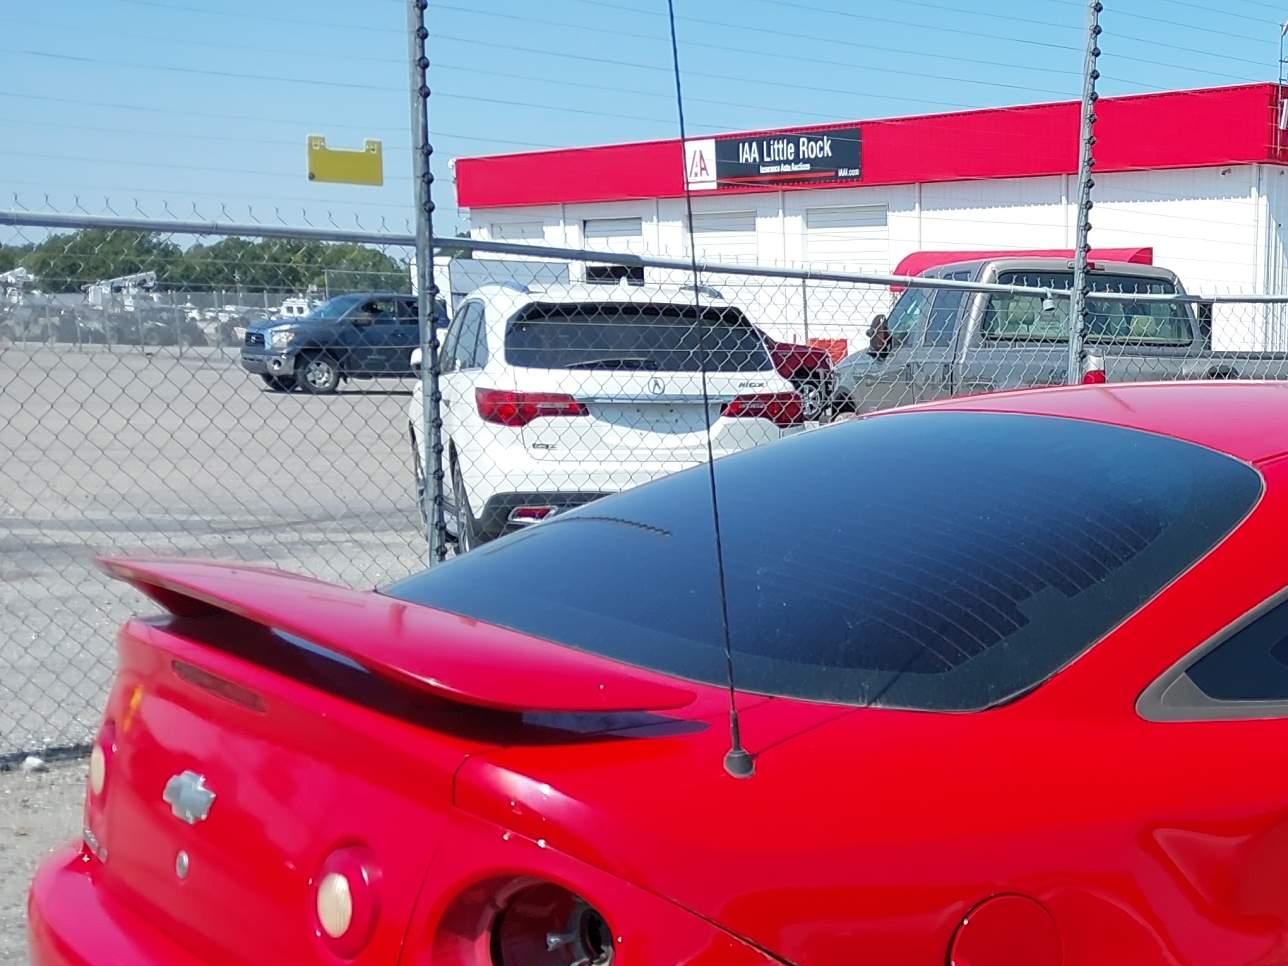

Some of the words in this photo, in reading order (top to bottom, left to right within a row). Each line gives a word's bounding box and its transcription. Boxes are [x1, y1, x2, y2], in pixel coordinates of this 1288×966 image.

[739, 141, 759, 164] IAA
[763, 138, 795, 162] Little
[799, 136, 832, 159] Rock
